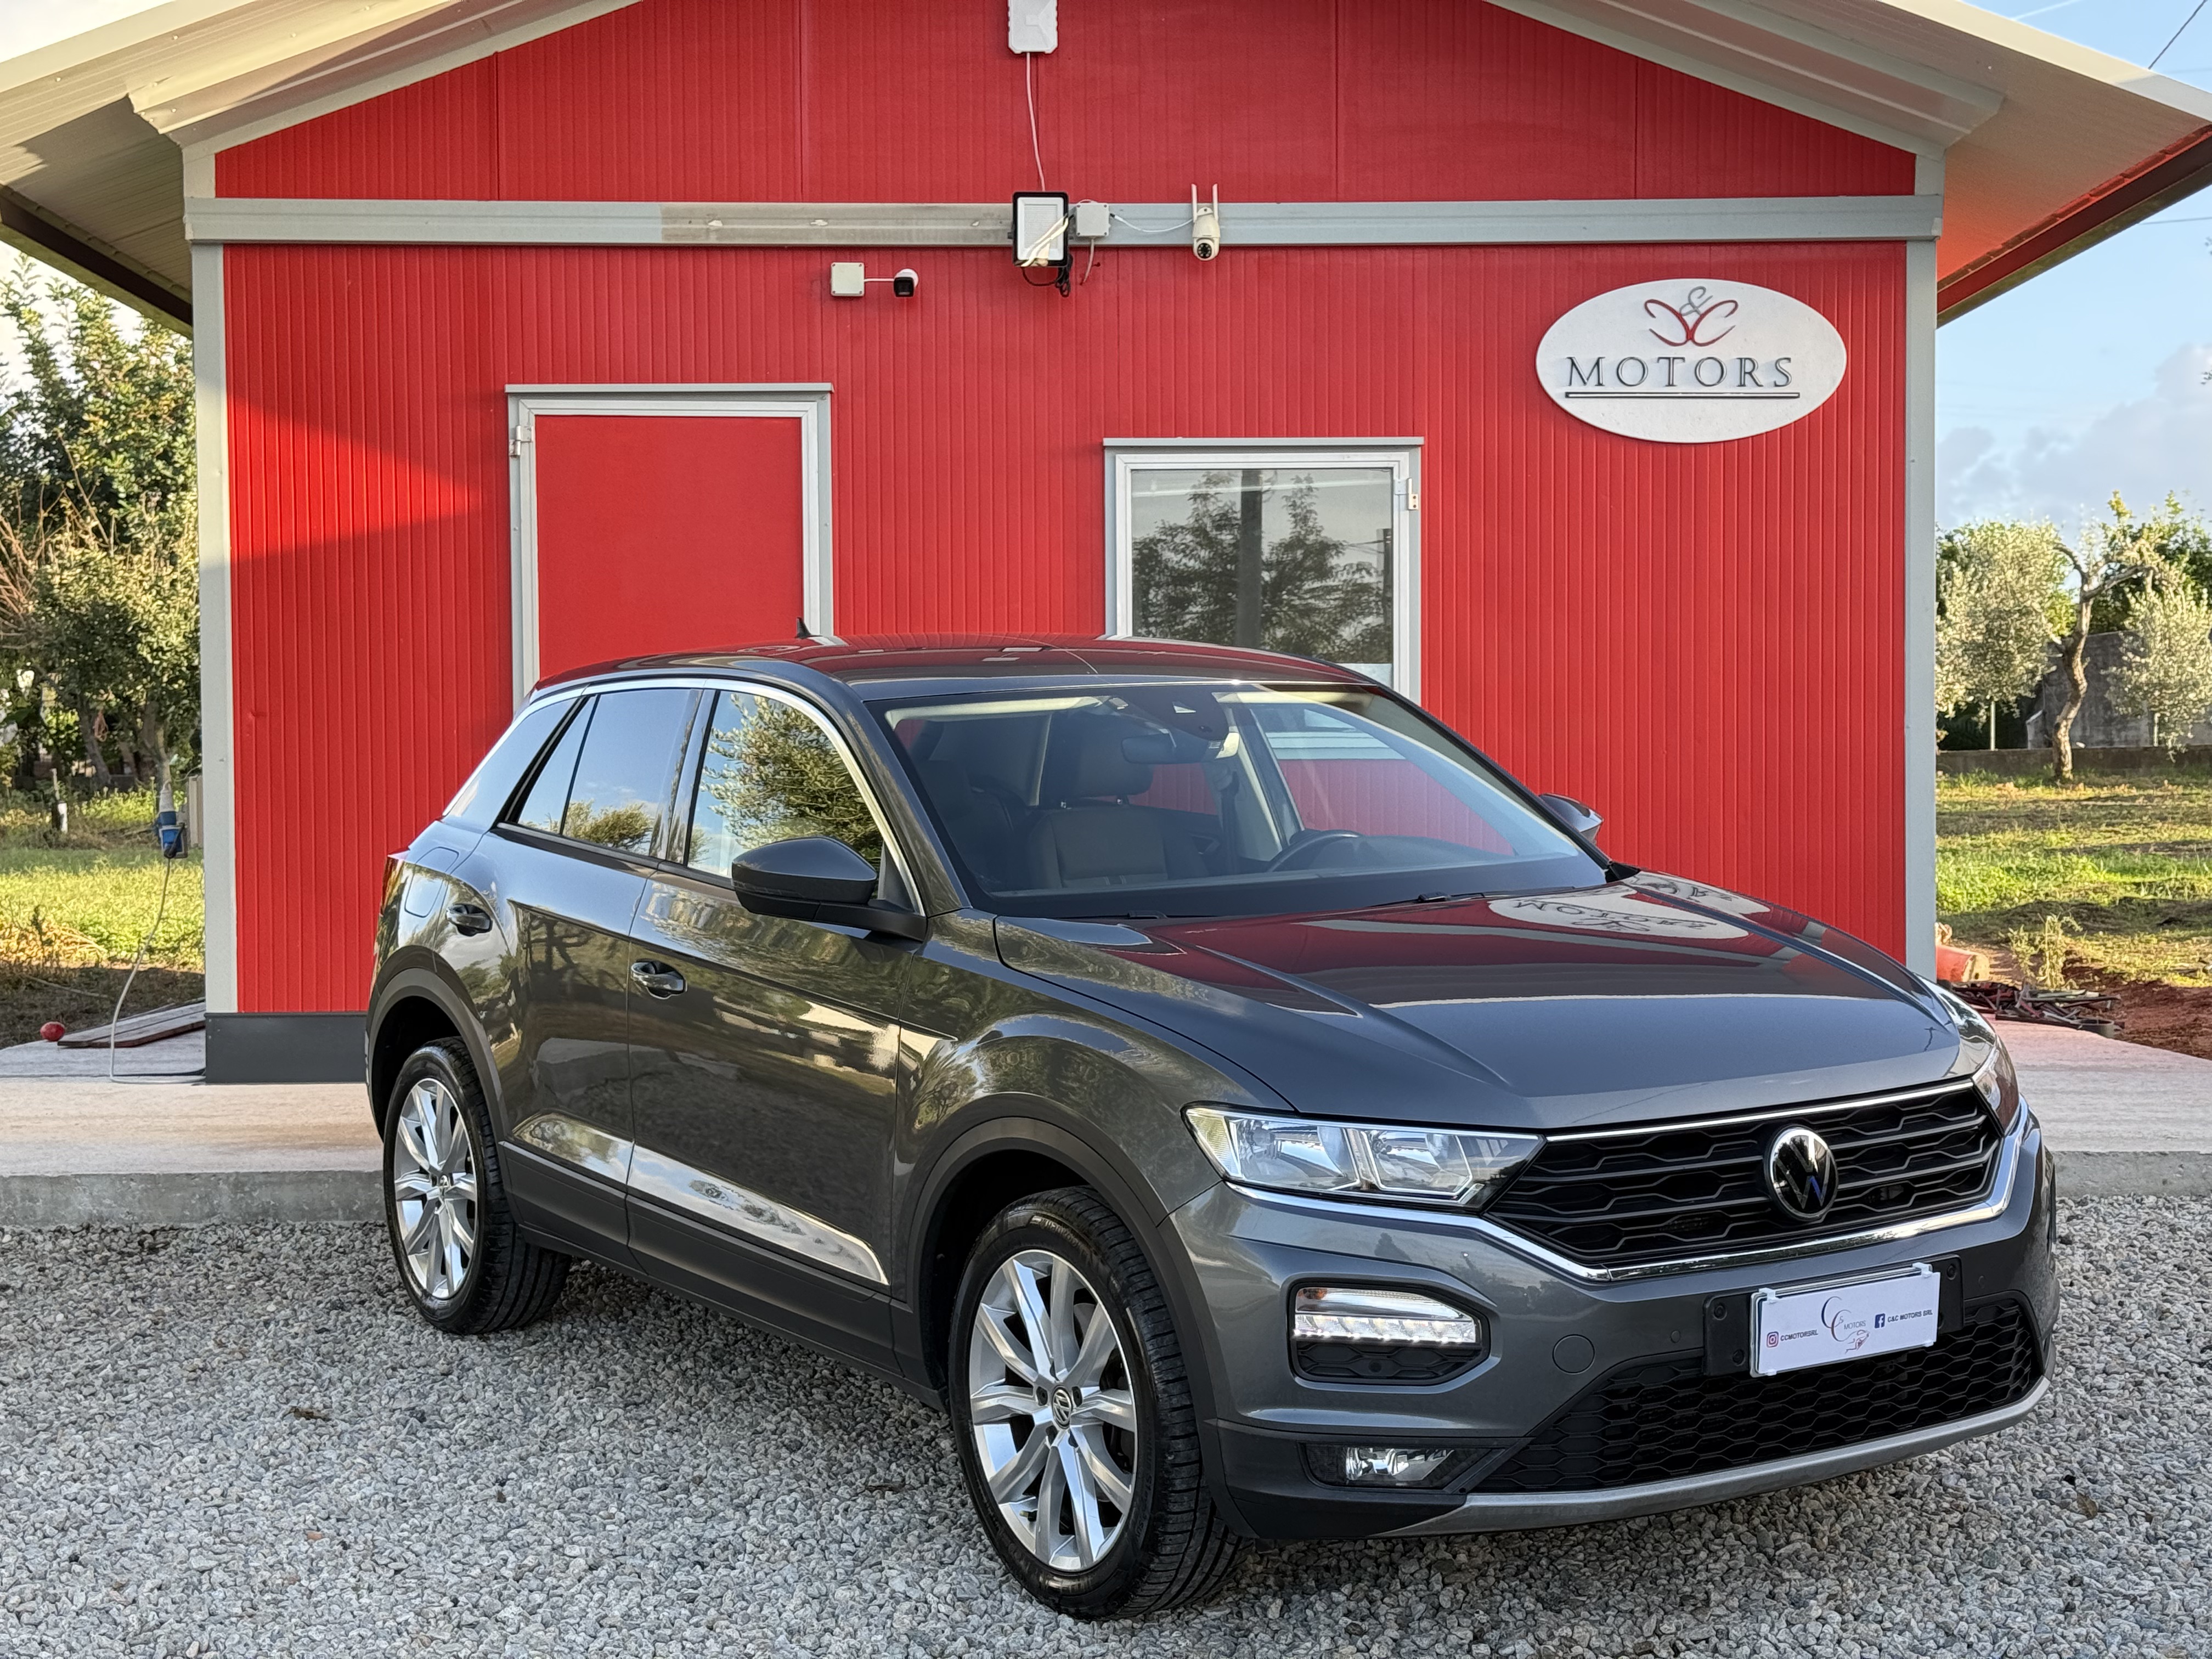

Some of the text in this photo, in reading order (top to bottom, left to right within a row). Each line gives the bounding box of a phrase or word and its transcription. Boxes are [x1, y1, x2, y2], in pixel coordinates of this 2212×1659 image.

[1566, 356, 1792, 387] MOTORS
[1900, 1311, 1922, 1320] MOTORS
[1844, 1320, 1866, 1330] MOTORS
